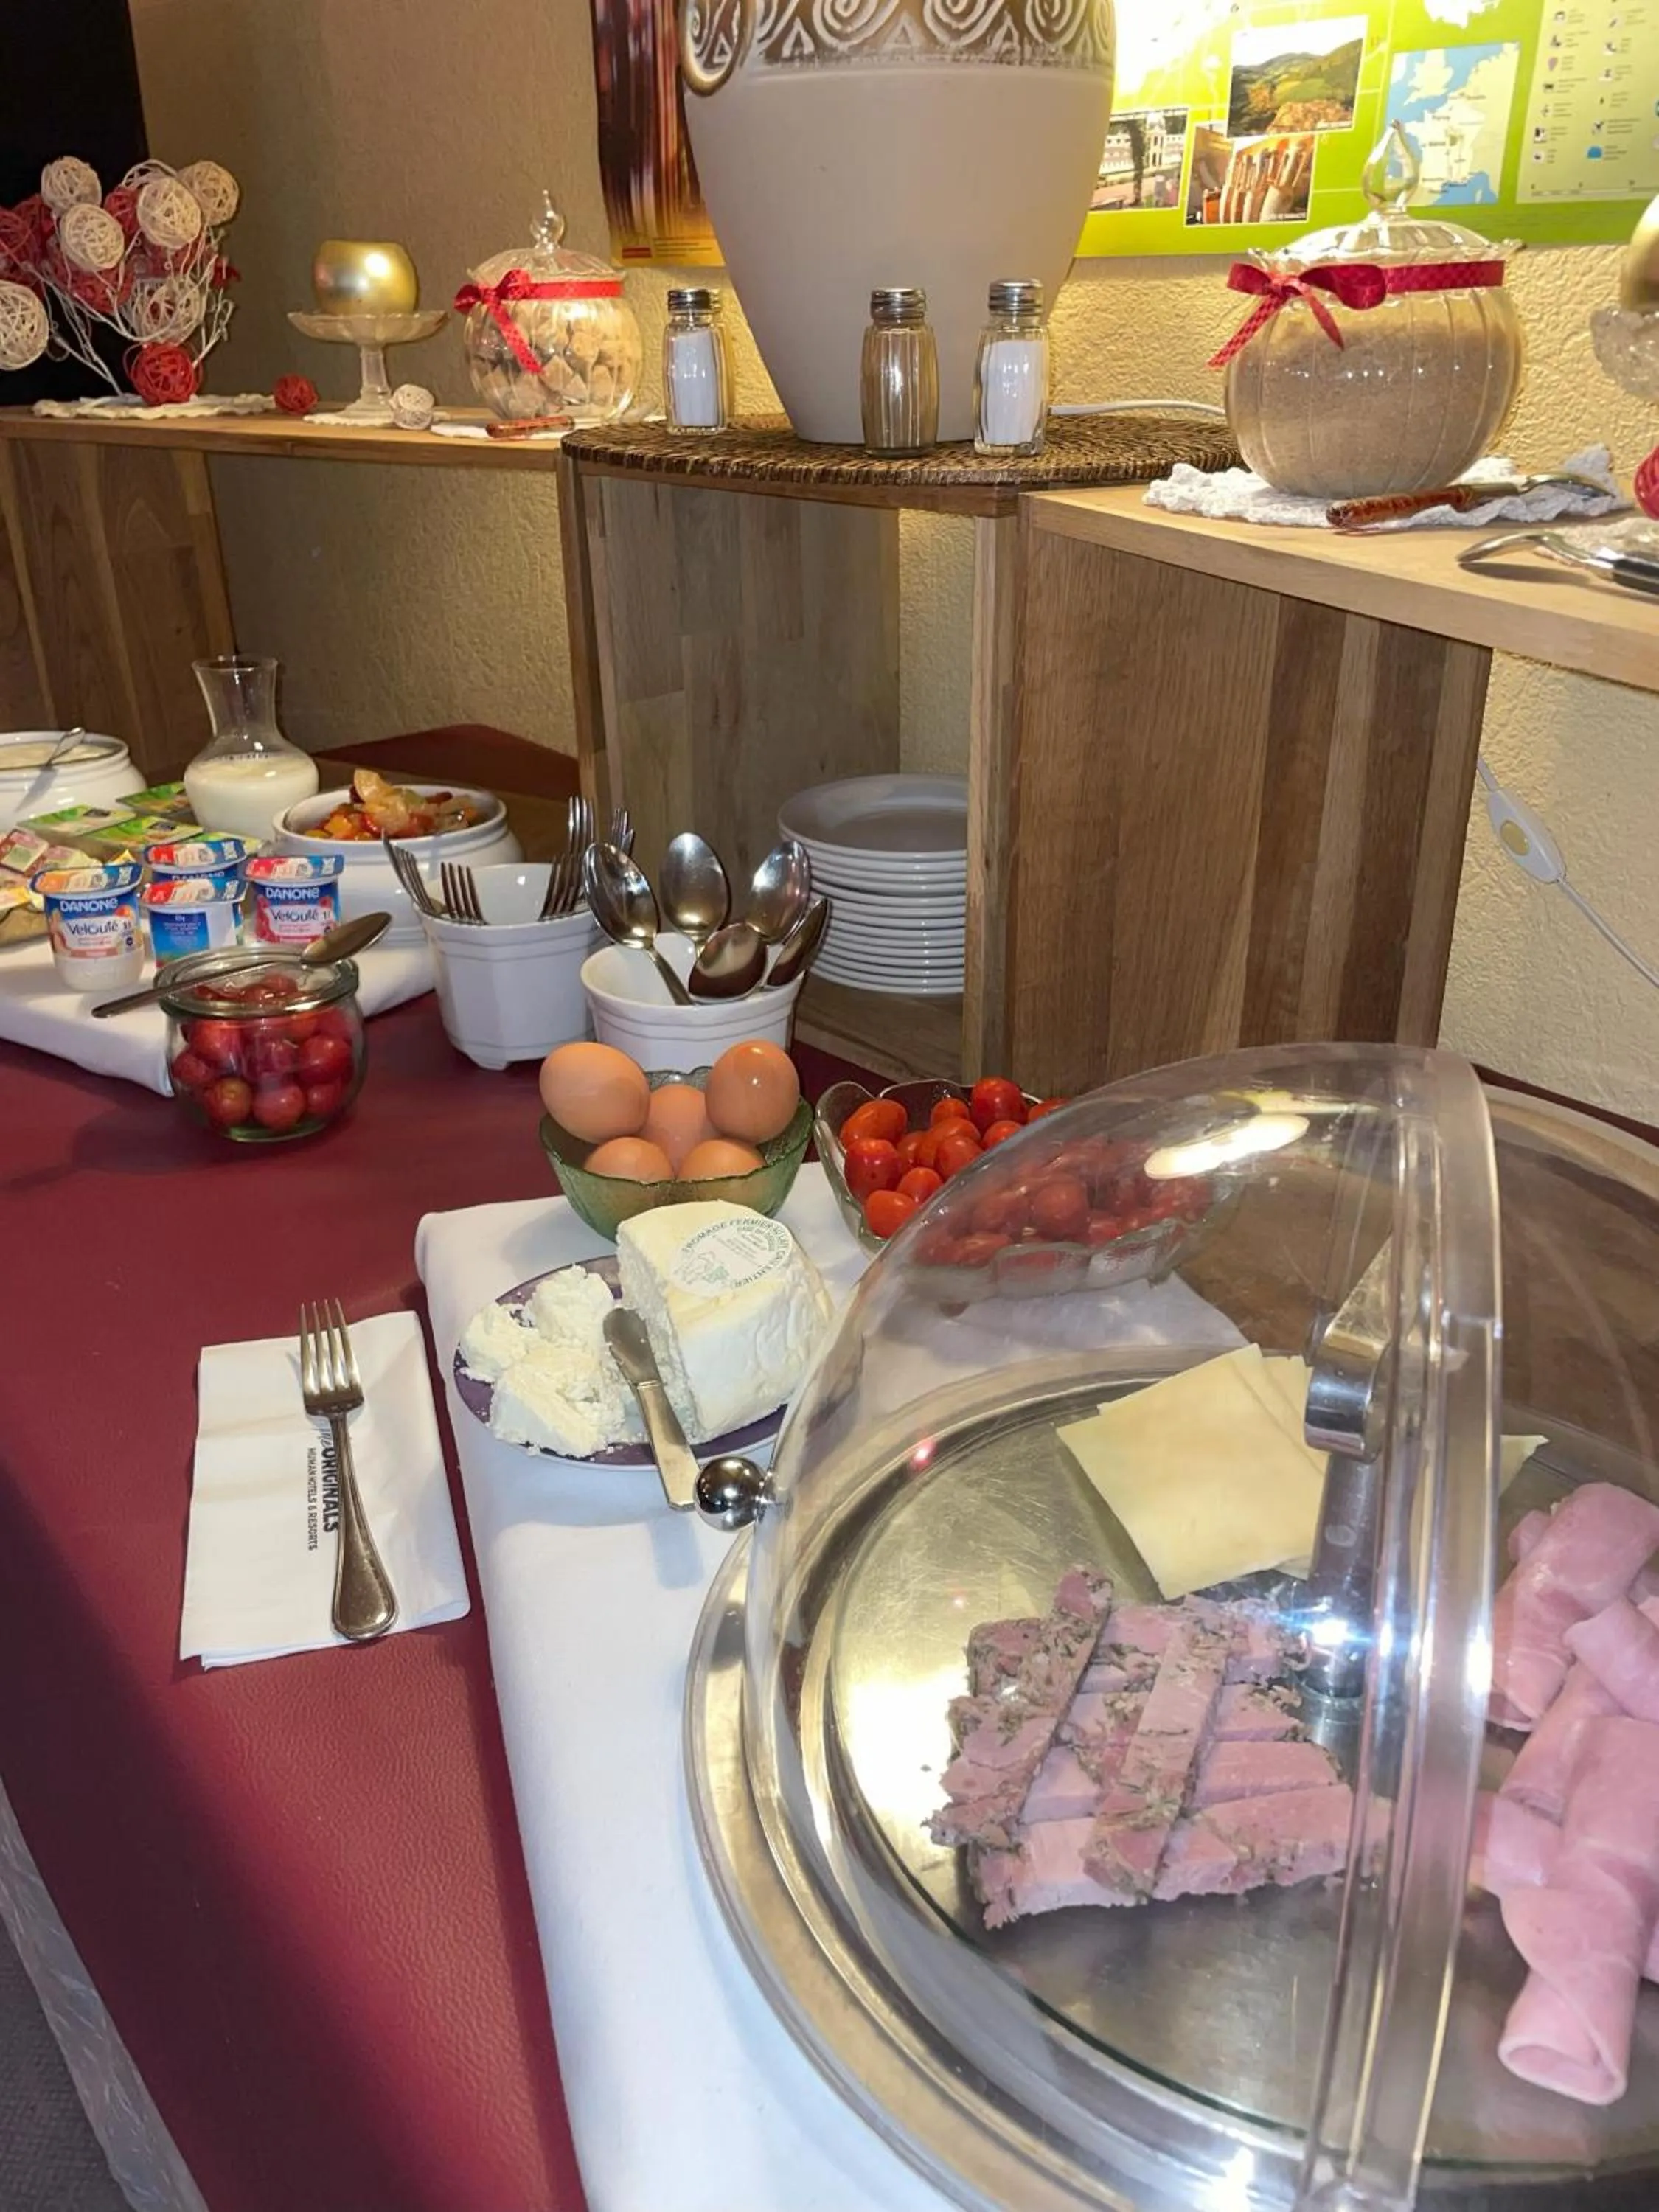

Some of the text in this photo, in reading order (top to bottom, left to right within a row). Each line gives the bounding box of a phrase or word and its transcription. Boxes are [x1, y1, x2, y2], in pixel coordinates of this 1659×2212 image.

[60, 897, 118, 912] DANONE
[265, 887, 319, 900] DANONE
[307, 1476, 317, 1503] HOTELS
[321, 1448, 339, 1534] ORIGINALS
[307, 1512, 318, 1551] RESORTS
